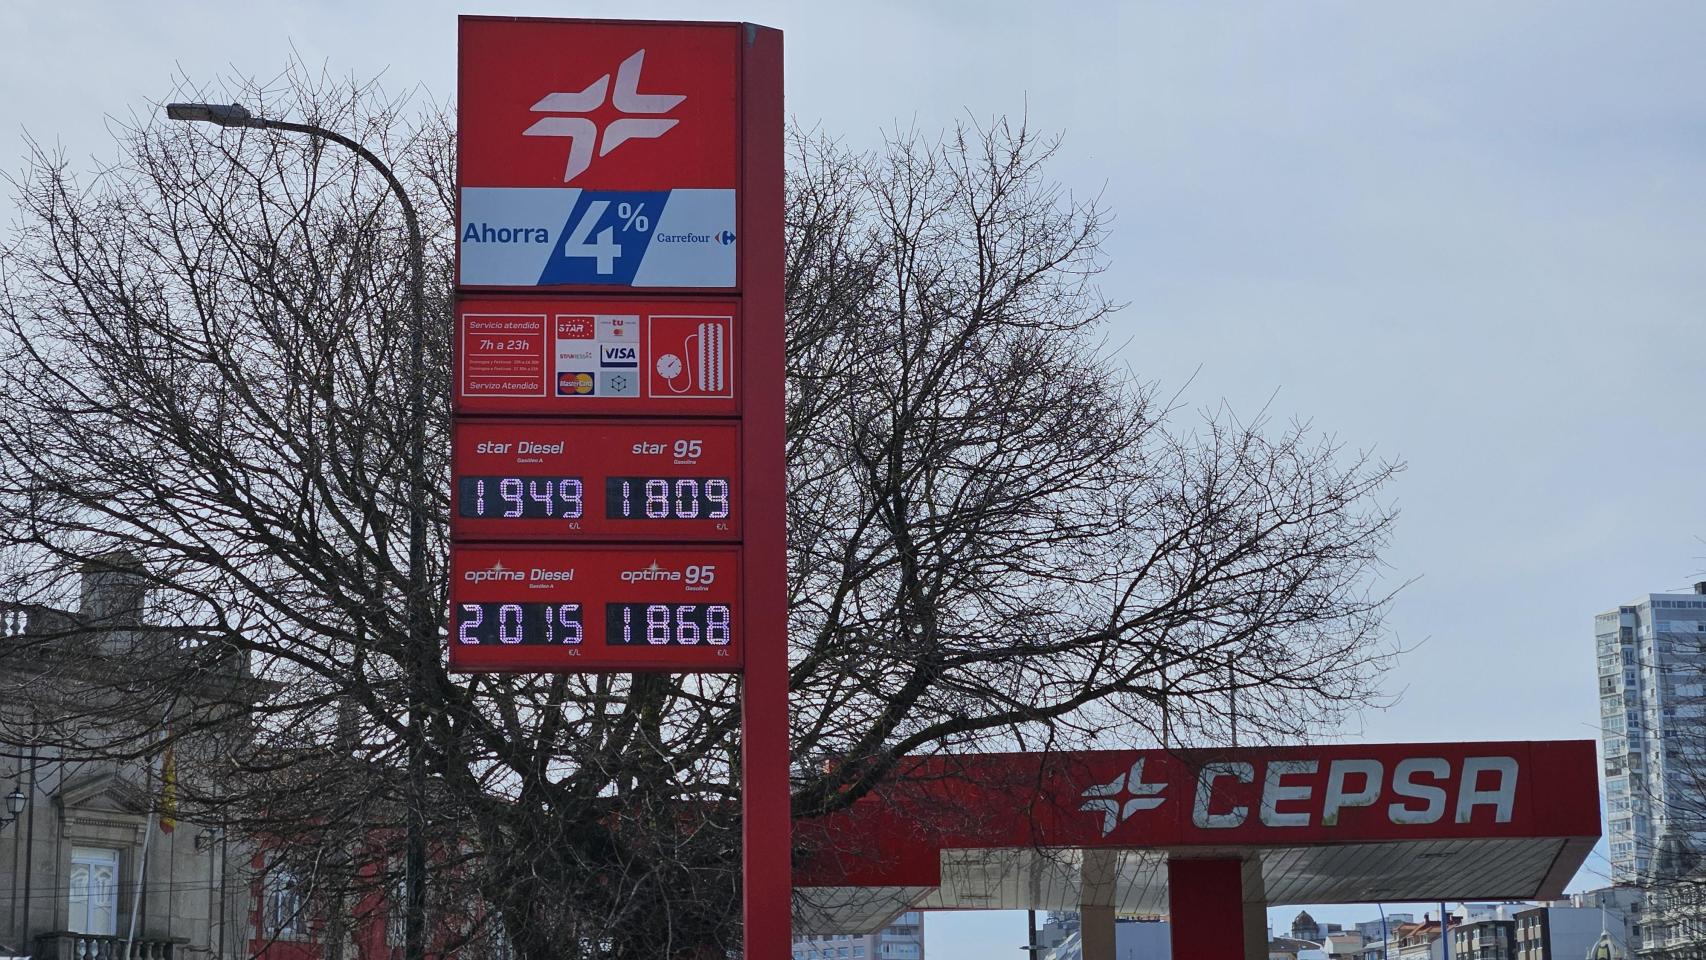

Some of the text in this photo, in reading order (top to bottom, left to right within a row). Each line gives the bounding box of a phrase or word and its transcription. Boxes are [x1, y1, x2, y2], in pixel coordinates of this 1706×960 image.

[462, 222, 549, 243] Ahorra
[657, 231, 711, 244] Carrefour
[470, 321, 540, 329] Servicio atendido
[558, 324, 584, 333] STAR
[612, 319, 624, 327] tu
[480, 339, 530, 350] 7h a 23h
[605, 347, 636, 360] VISA
[470, 381, 538, 390] Servizo Atendido
[476, 441, 565, 454] star Diesel
[632, 440, 703, 458] star 95
[464, 568, 575, 585] optima Diesel
[620, 565, 716, 585] optima 95
[1191, 756, 1519, 829] CEPSA
